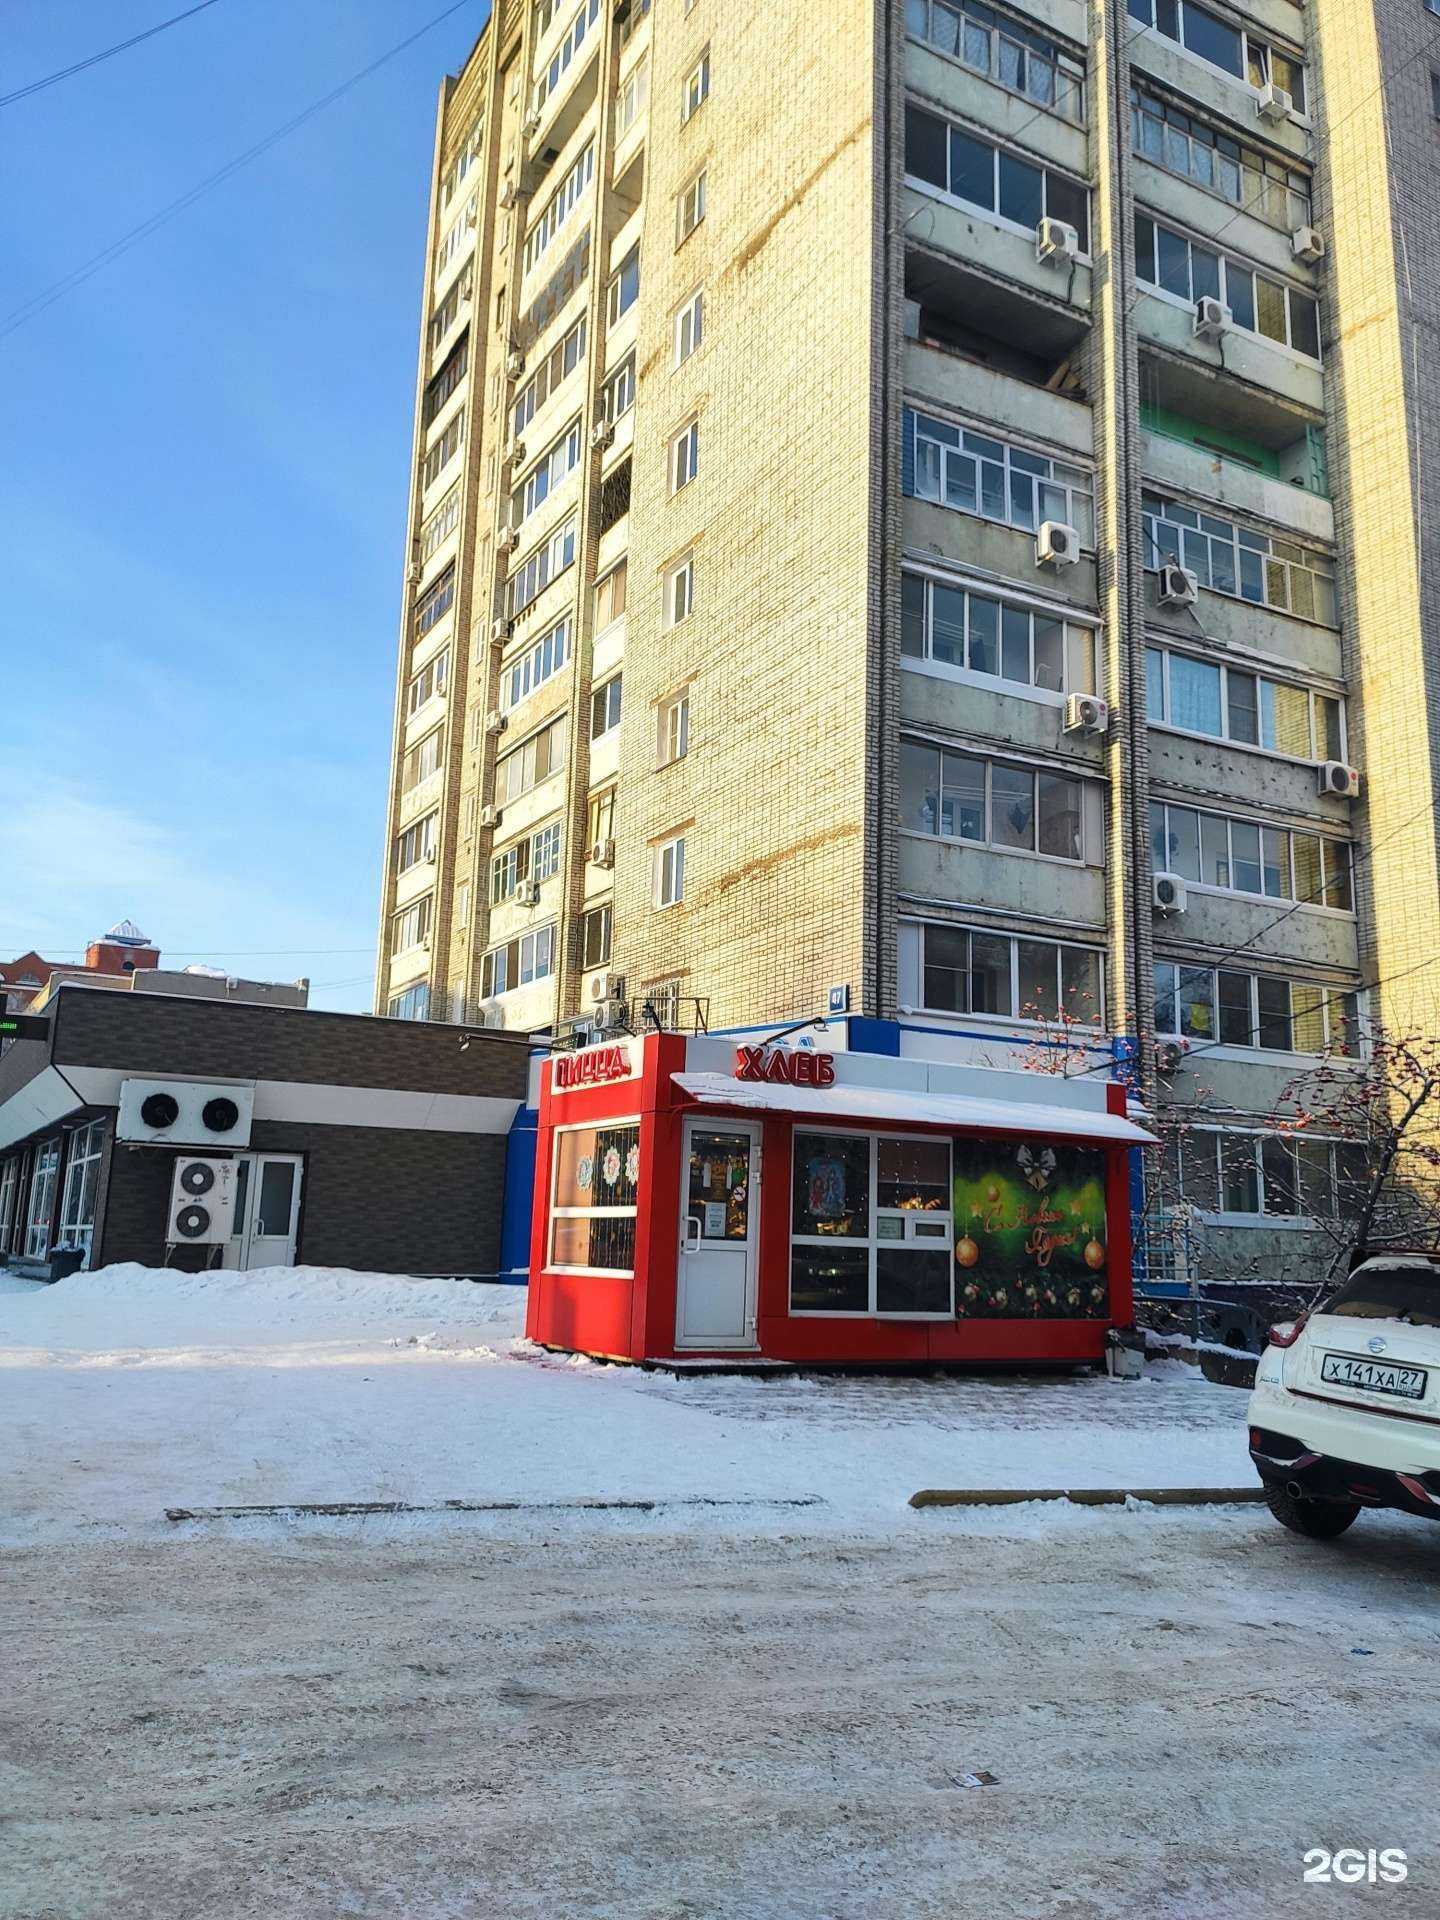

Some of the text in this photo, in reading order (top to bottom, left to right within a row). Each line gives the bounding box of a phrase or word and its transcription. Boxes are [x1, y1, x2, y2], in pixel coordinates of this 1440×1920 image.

[557, 1045, 631, 1088] ПИЦЦА
[736, 1046, 836, 1089] ХЛЕБ
[1400, 1370, 1418, 1386] 27
